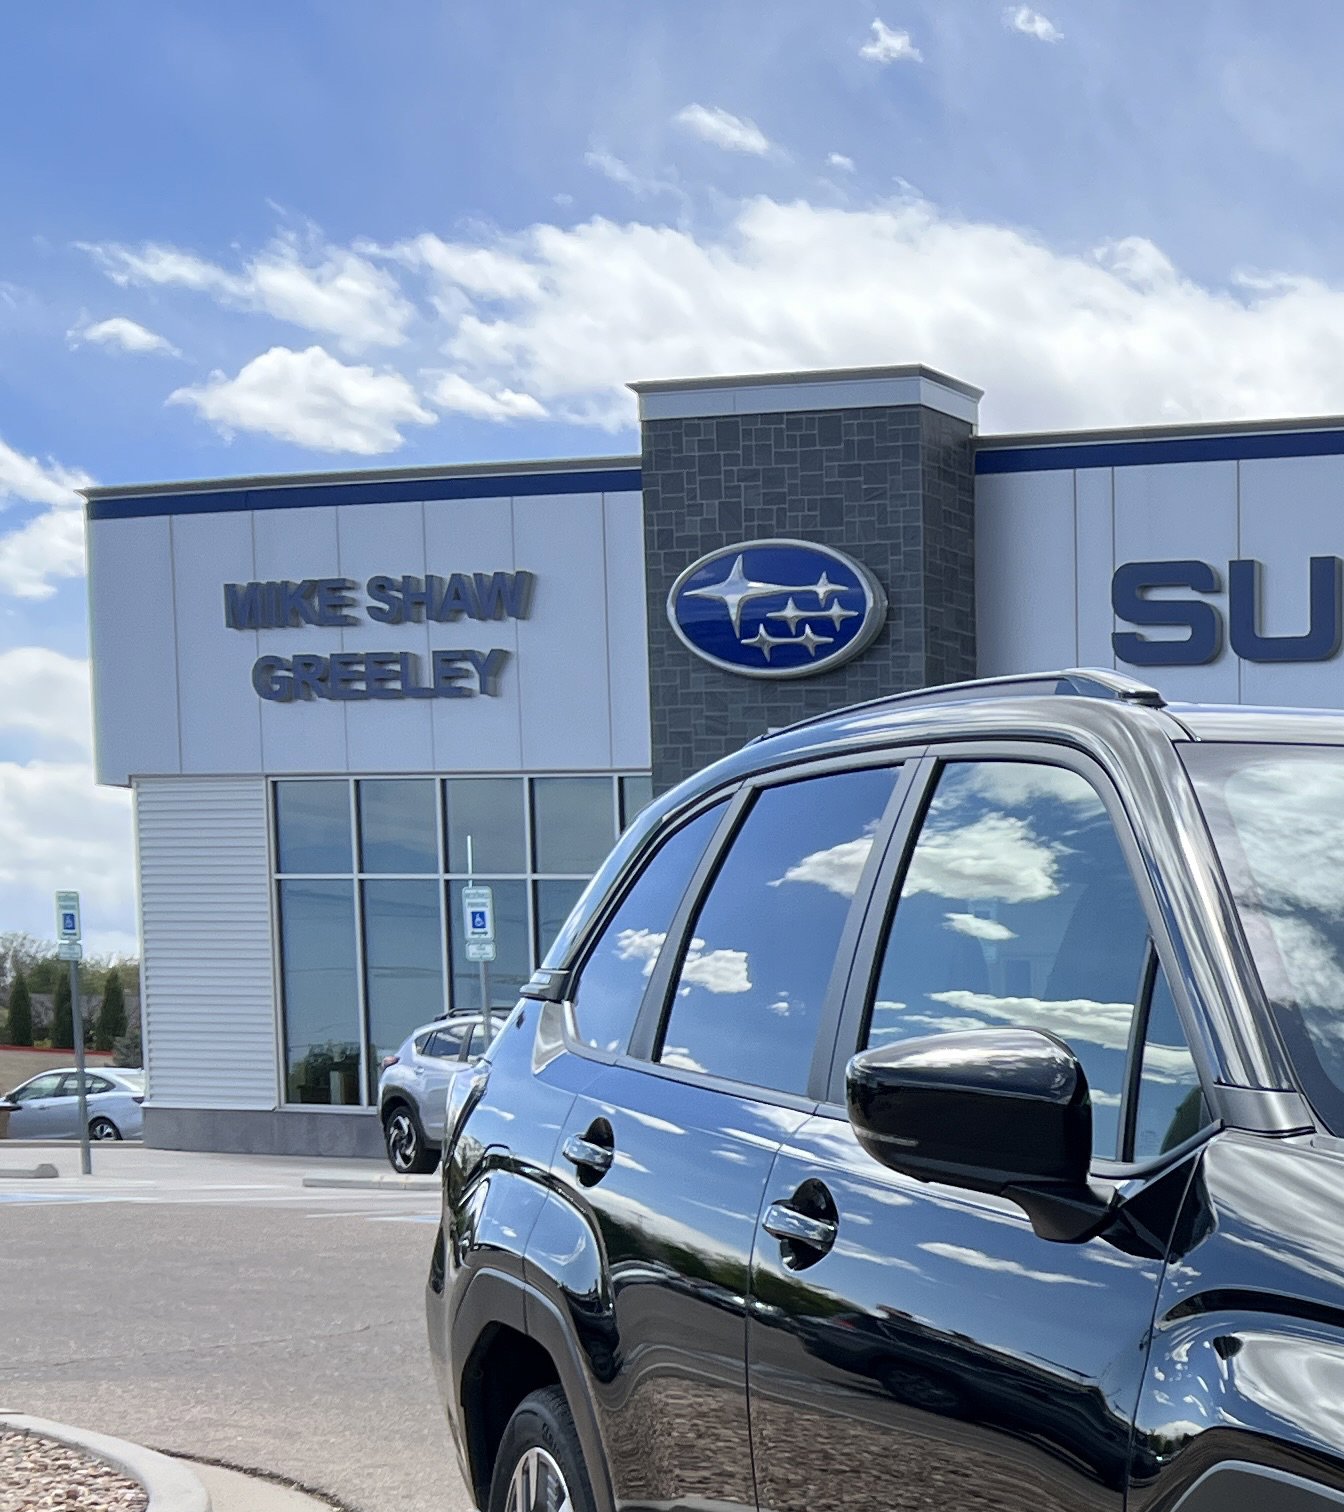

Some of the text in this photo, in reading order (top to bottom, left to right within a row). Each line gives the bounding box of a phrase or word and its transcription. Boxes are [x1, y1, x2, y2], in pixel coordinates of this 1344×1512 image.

[223, 571, 536, 630] MIKE SHAW
[252, 649, 512, 703] GREELEY
